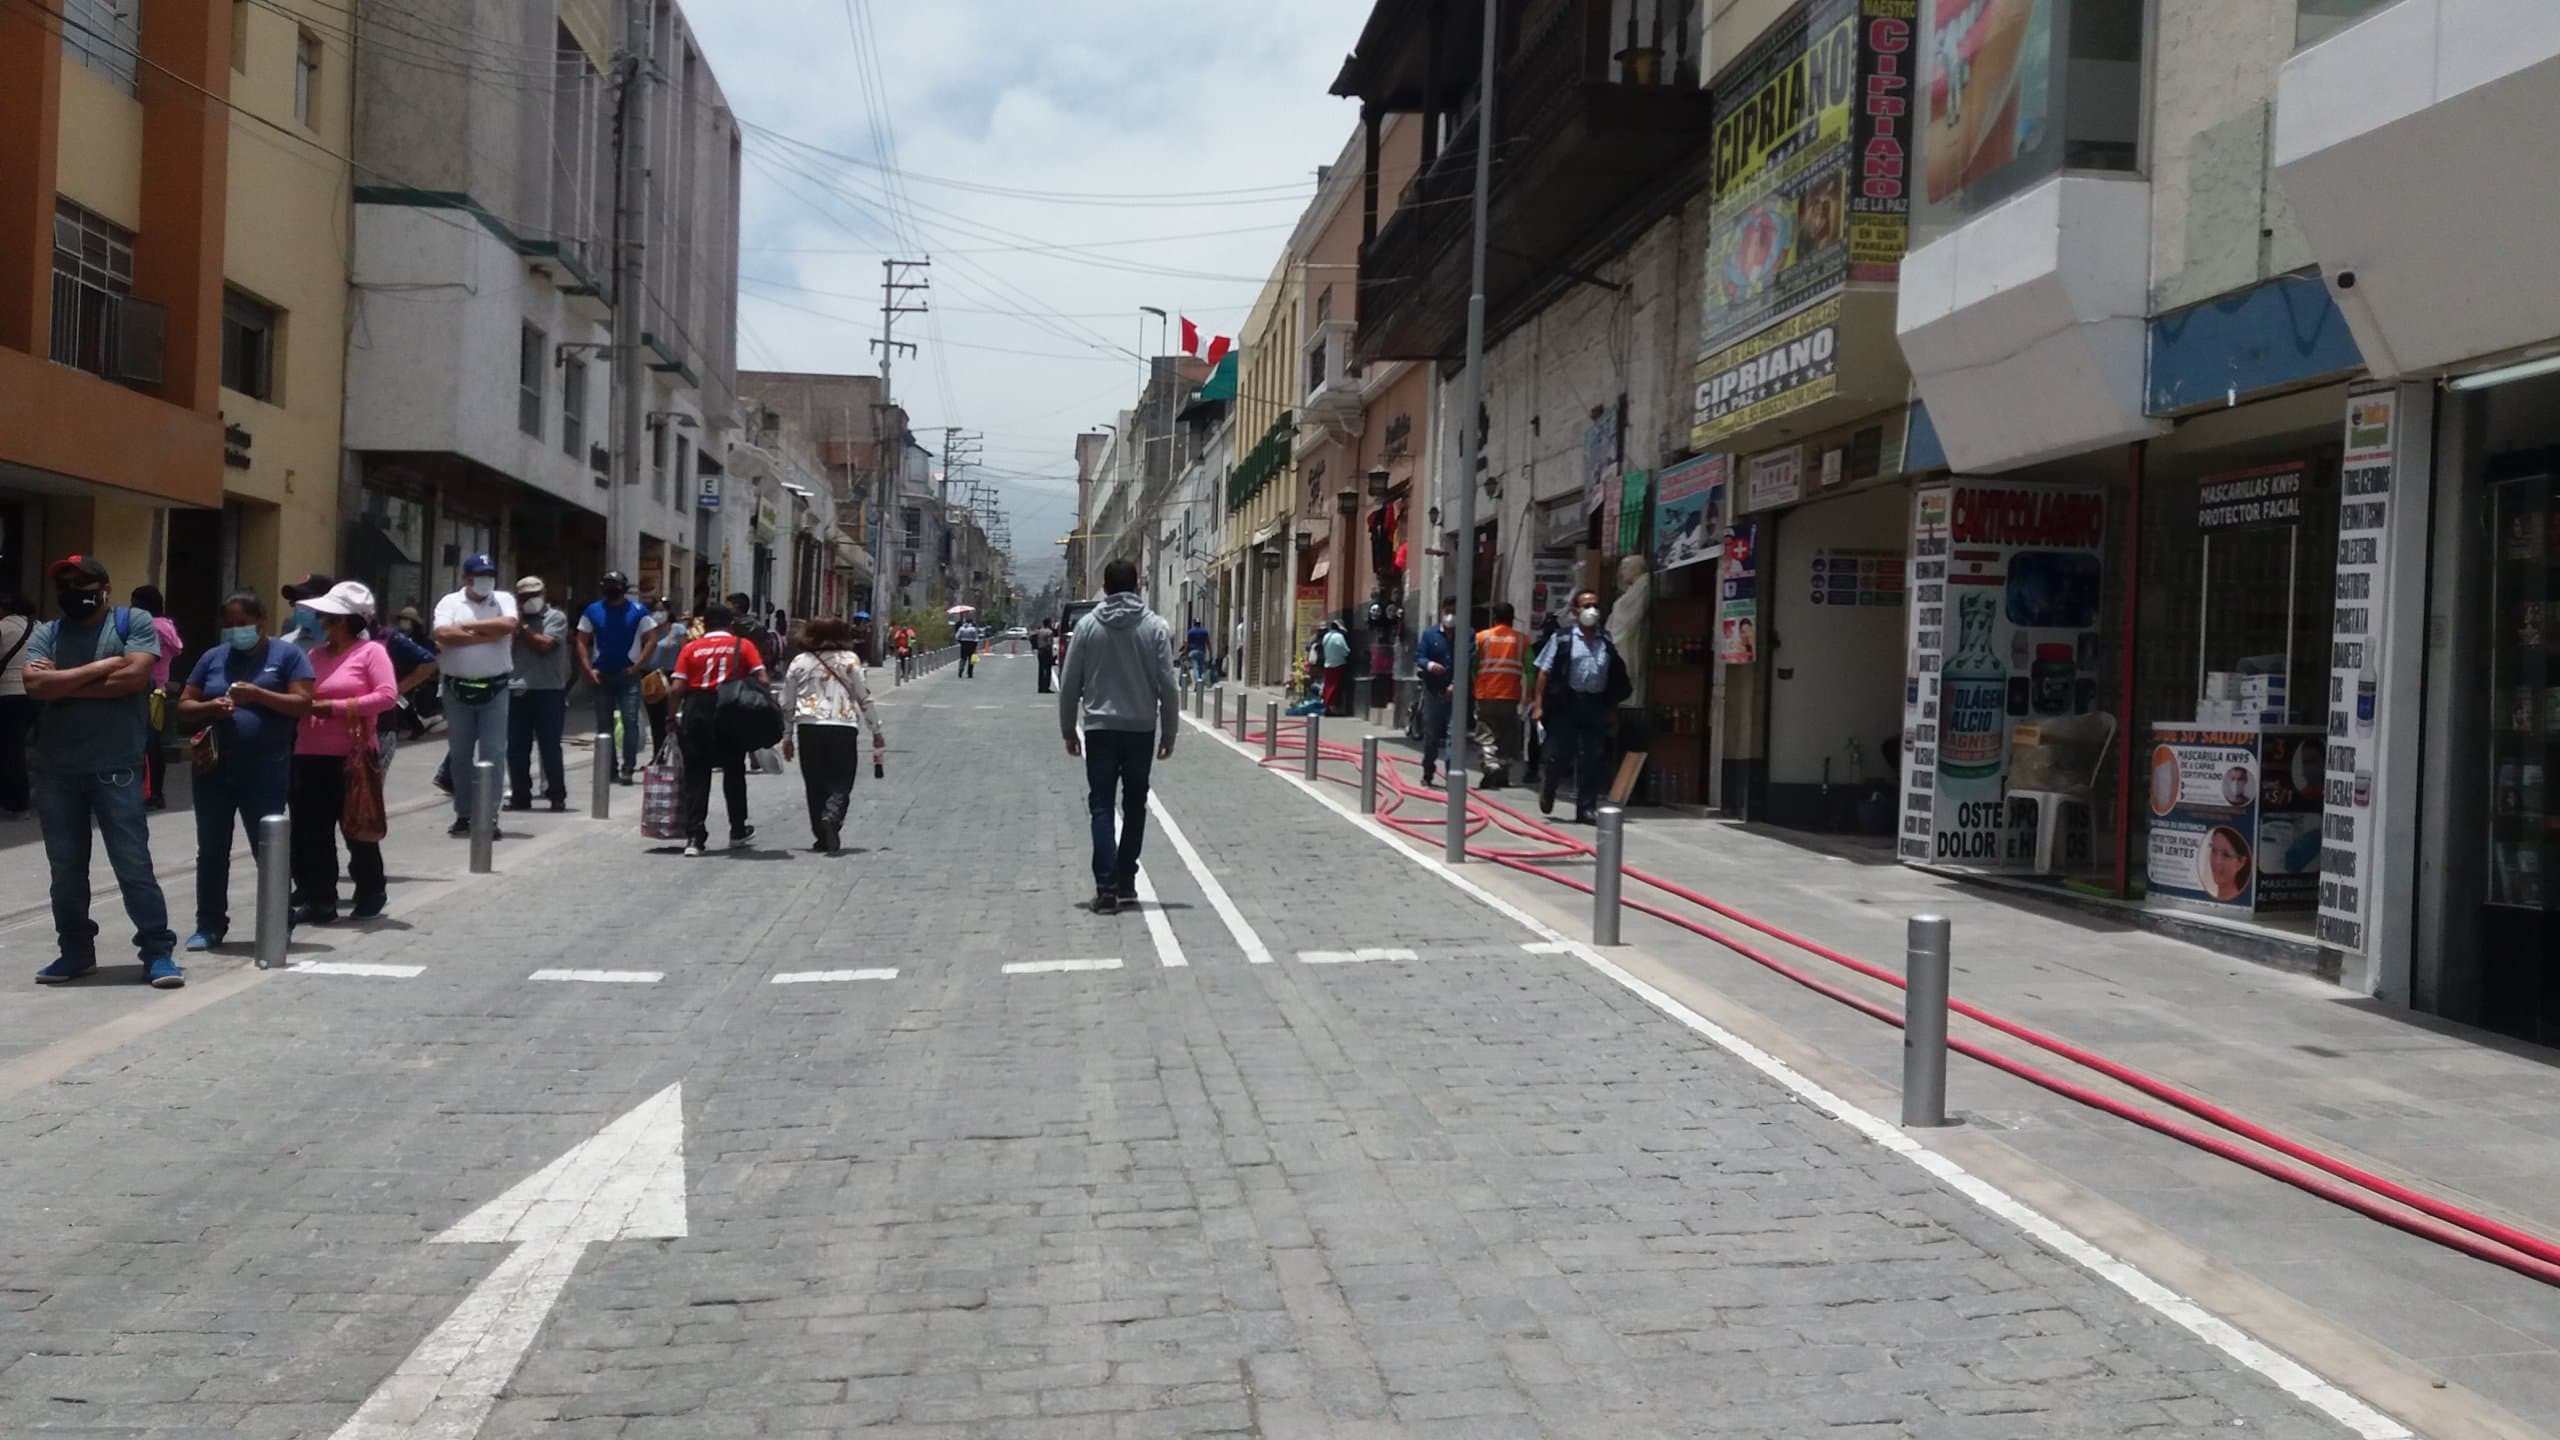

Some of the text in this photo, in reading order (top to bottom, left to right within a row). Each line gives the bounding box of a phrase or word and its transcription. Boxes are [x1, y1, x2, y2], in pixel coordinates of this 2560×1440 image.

[1715, 24, 1850, 195] CIPRIANO
[1863, 18, 1909, 197] CIPRIANO
[1853, 197, 1908, 211] DE LA PAZ
[1695, 327, 1834, 411] CIPRIANO
[1694, 391, 1755, 426] DE LA PAZ
[705, 480, 713, 494] E
[2200, 473, 2300, 504] MASCARILLAS KN95
[2199, 497, 2301, 527] PROTECTOR FACIAL
[2178, 751, 2250, 763] MASCARILLA KN95
[1938, 831, 1996, 858] DOLOR
[2165, 846, 2195, 858] LENTES
